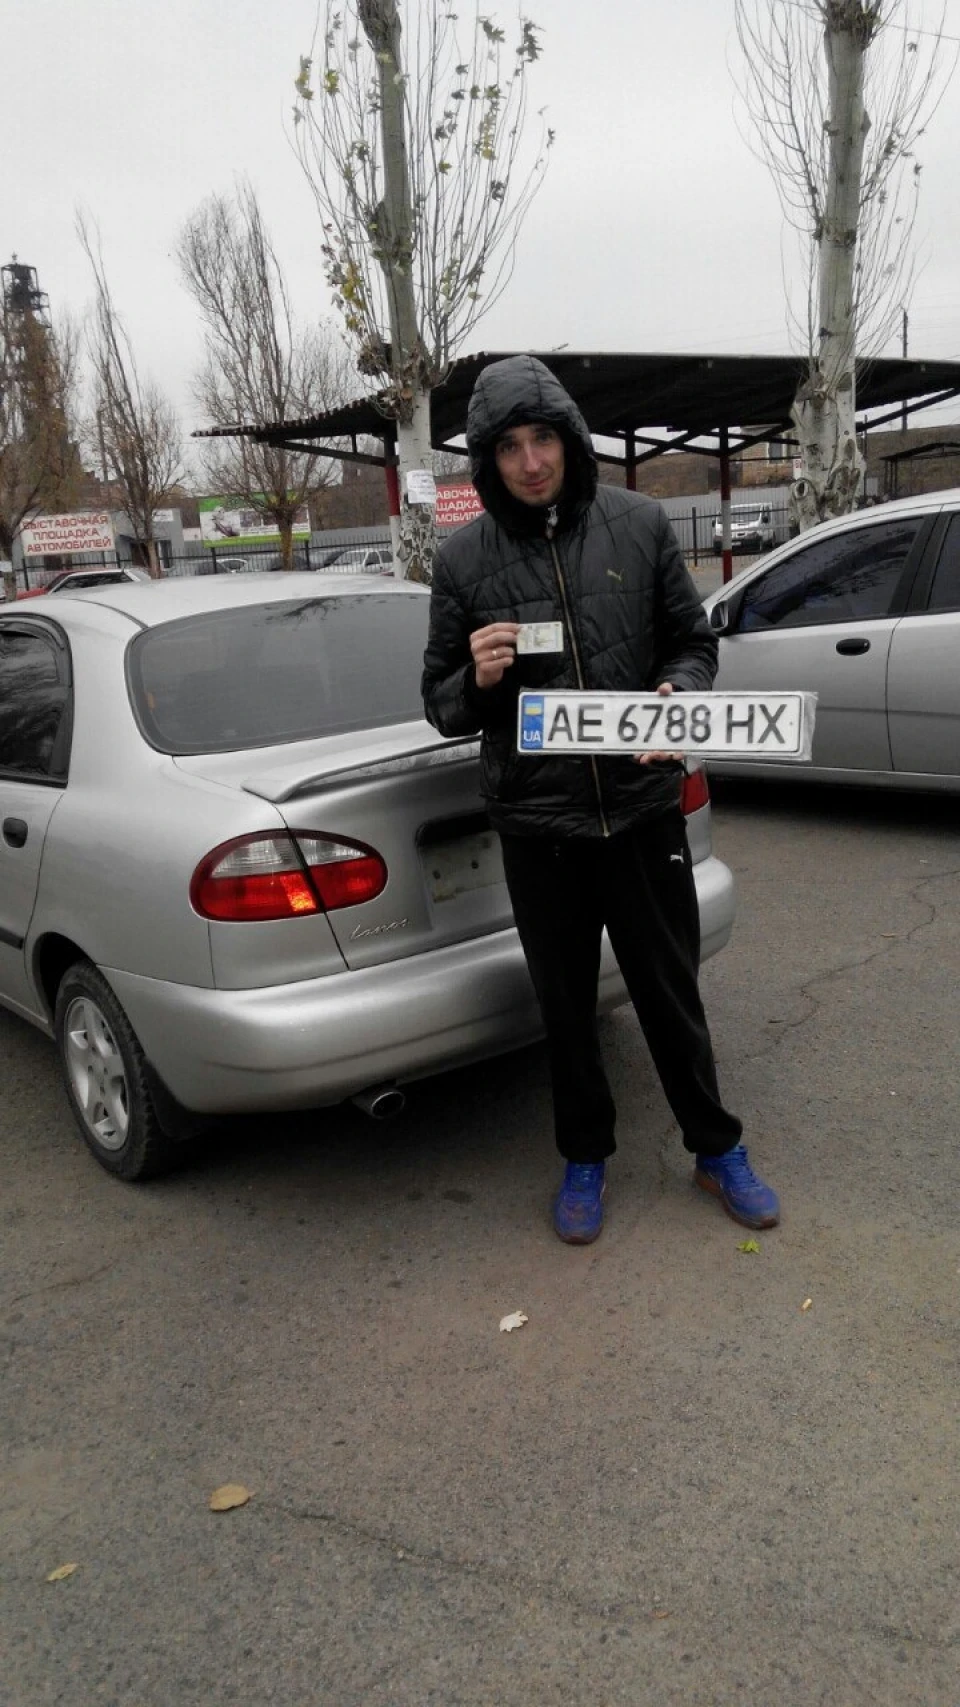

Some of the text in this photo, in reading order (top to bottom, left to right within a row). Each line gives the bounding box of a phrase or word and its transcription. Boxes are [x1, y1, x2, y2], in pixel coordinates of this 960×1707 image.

[23, 514, 109, 530] ВЫСТАВОЧНАЯ
[33, 527, 100, 541] ПЛОЩАДКА
[27, 536, 112, 553] АВТОМОБИЛЕЙ
[547, 703, 788, 744] AE 6788 HX
[523, 730, 541, 742] UA
